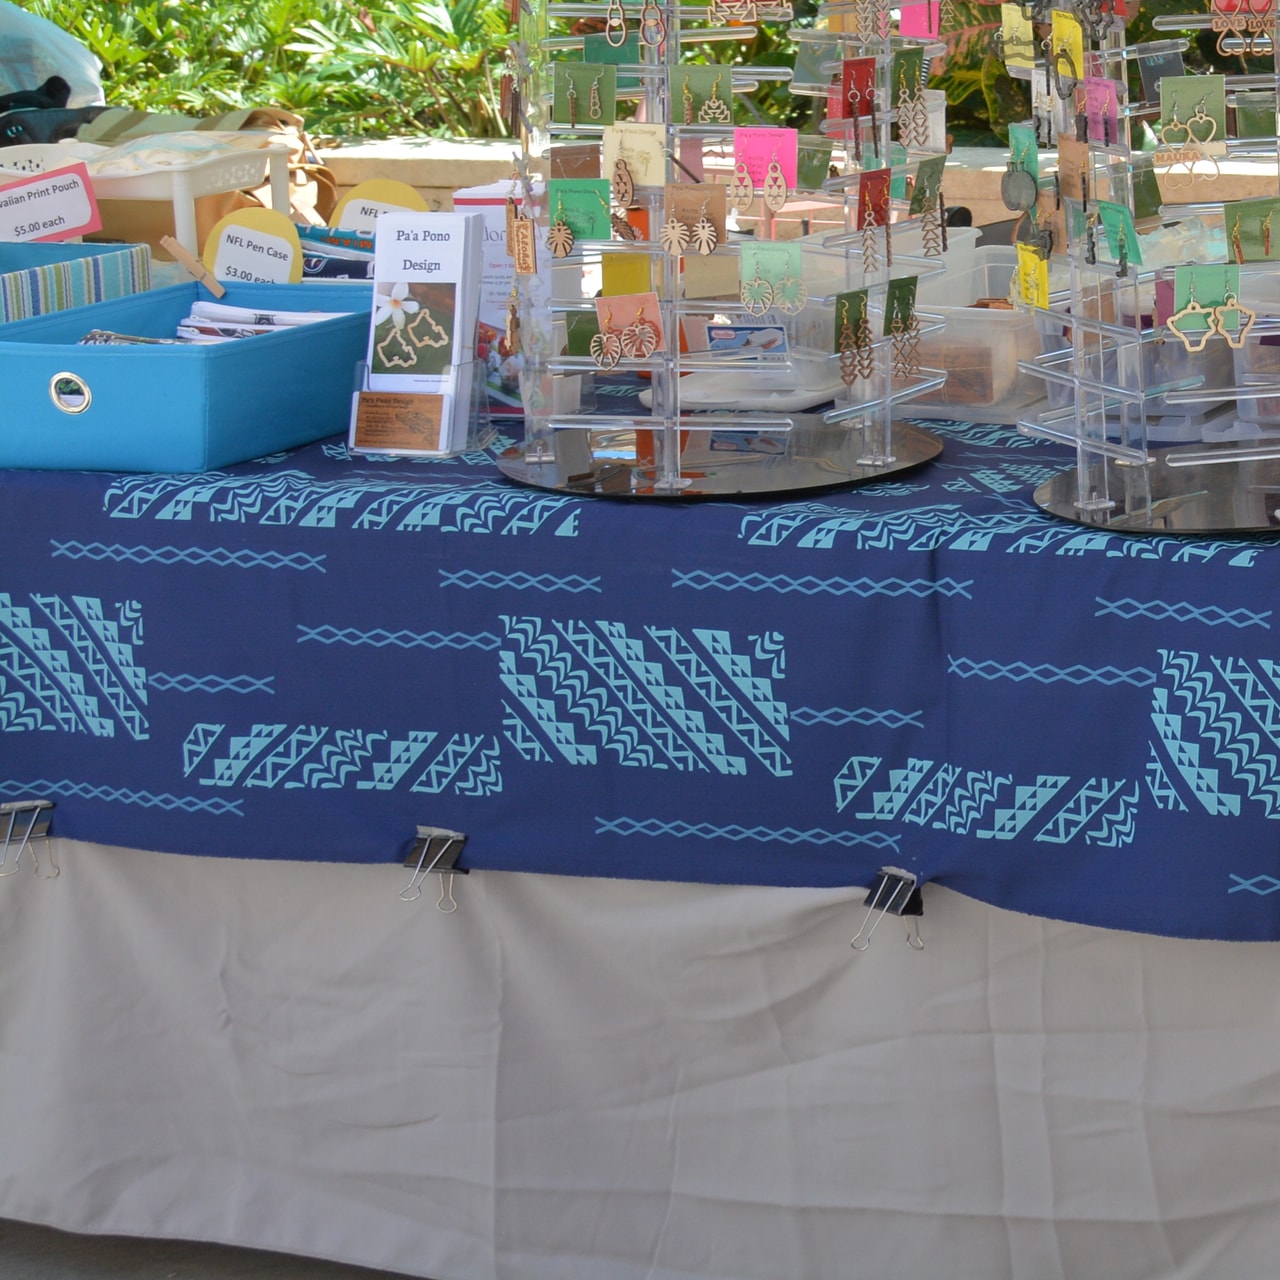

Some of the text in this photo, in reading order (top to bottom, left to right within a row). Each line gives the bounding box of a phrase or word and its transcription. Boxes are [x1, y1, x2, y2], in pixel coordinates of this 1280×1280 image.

[1214, 19, 1275, 29] LOVE LOVE
[1155, 150, 1200, 163] MAUKA
[27, 187, 50, 202] Print
[51, 178, 80, 195] Pouch
[360, 206, 379, 218] NFL
[14, 214, 65, 237] $5.00 each
[396, 230, 451, 242] Pa'a Pono
[225, 233, 289, 262] NFL Pen Case
[225, 265, 253, 283] $3.00
[402, 259, 441, 274] Design
